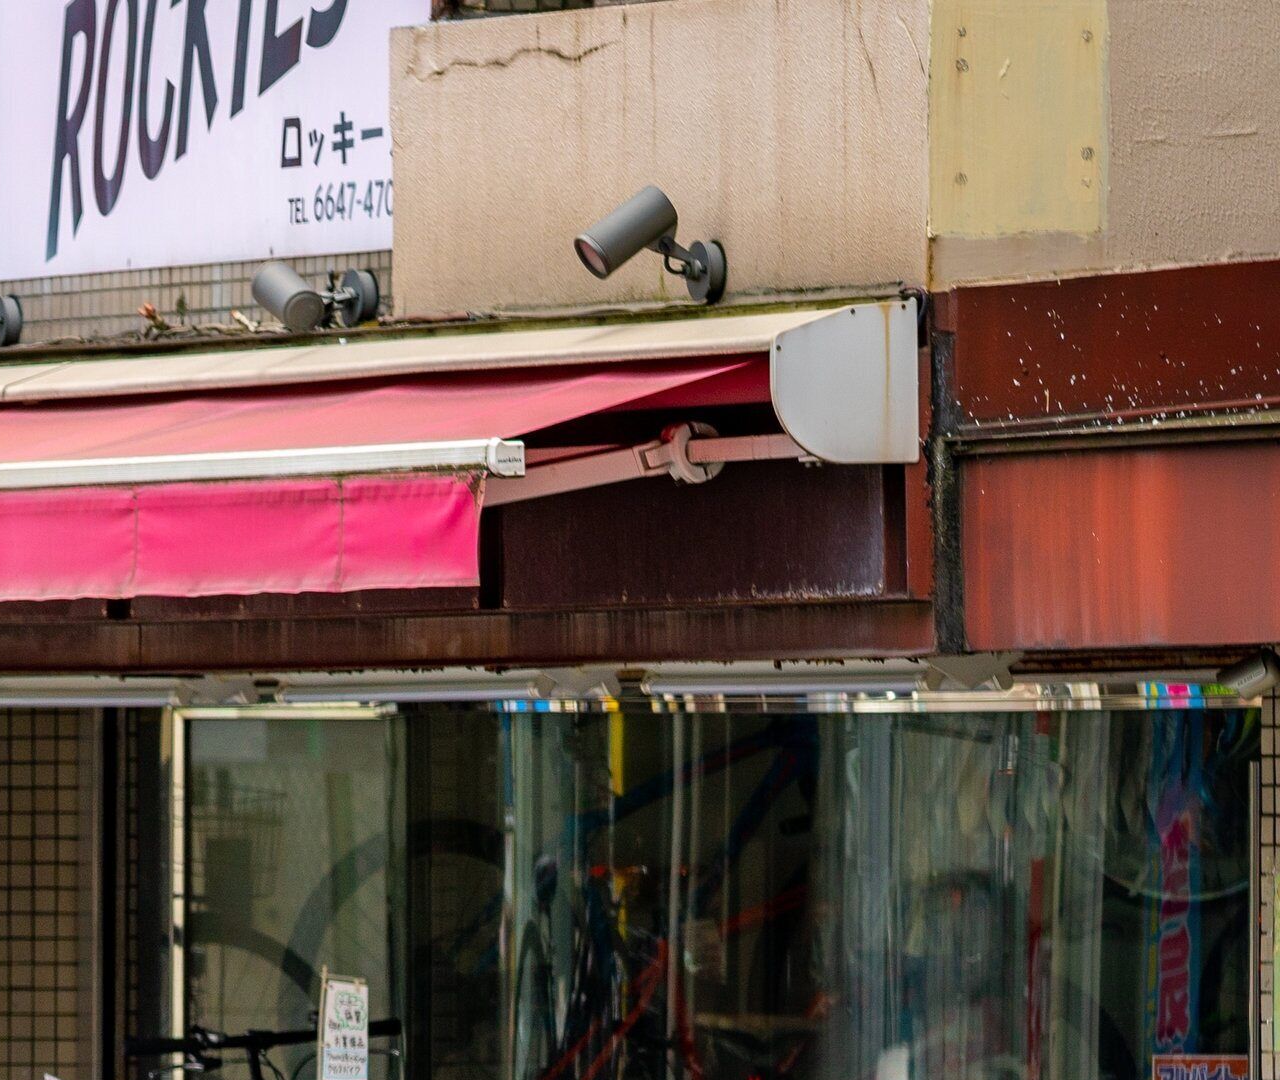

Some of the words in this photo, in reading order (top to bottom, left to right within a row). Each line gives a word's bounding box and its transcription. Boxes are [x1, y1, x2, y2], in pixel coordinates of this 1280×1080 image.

[281, 111, 393, 168] ロッキー
[289, 197, 309, 224] TEL
